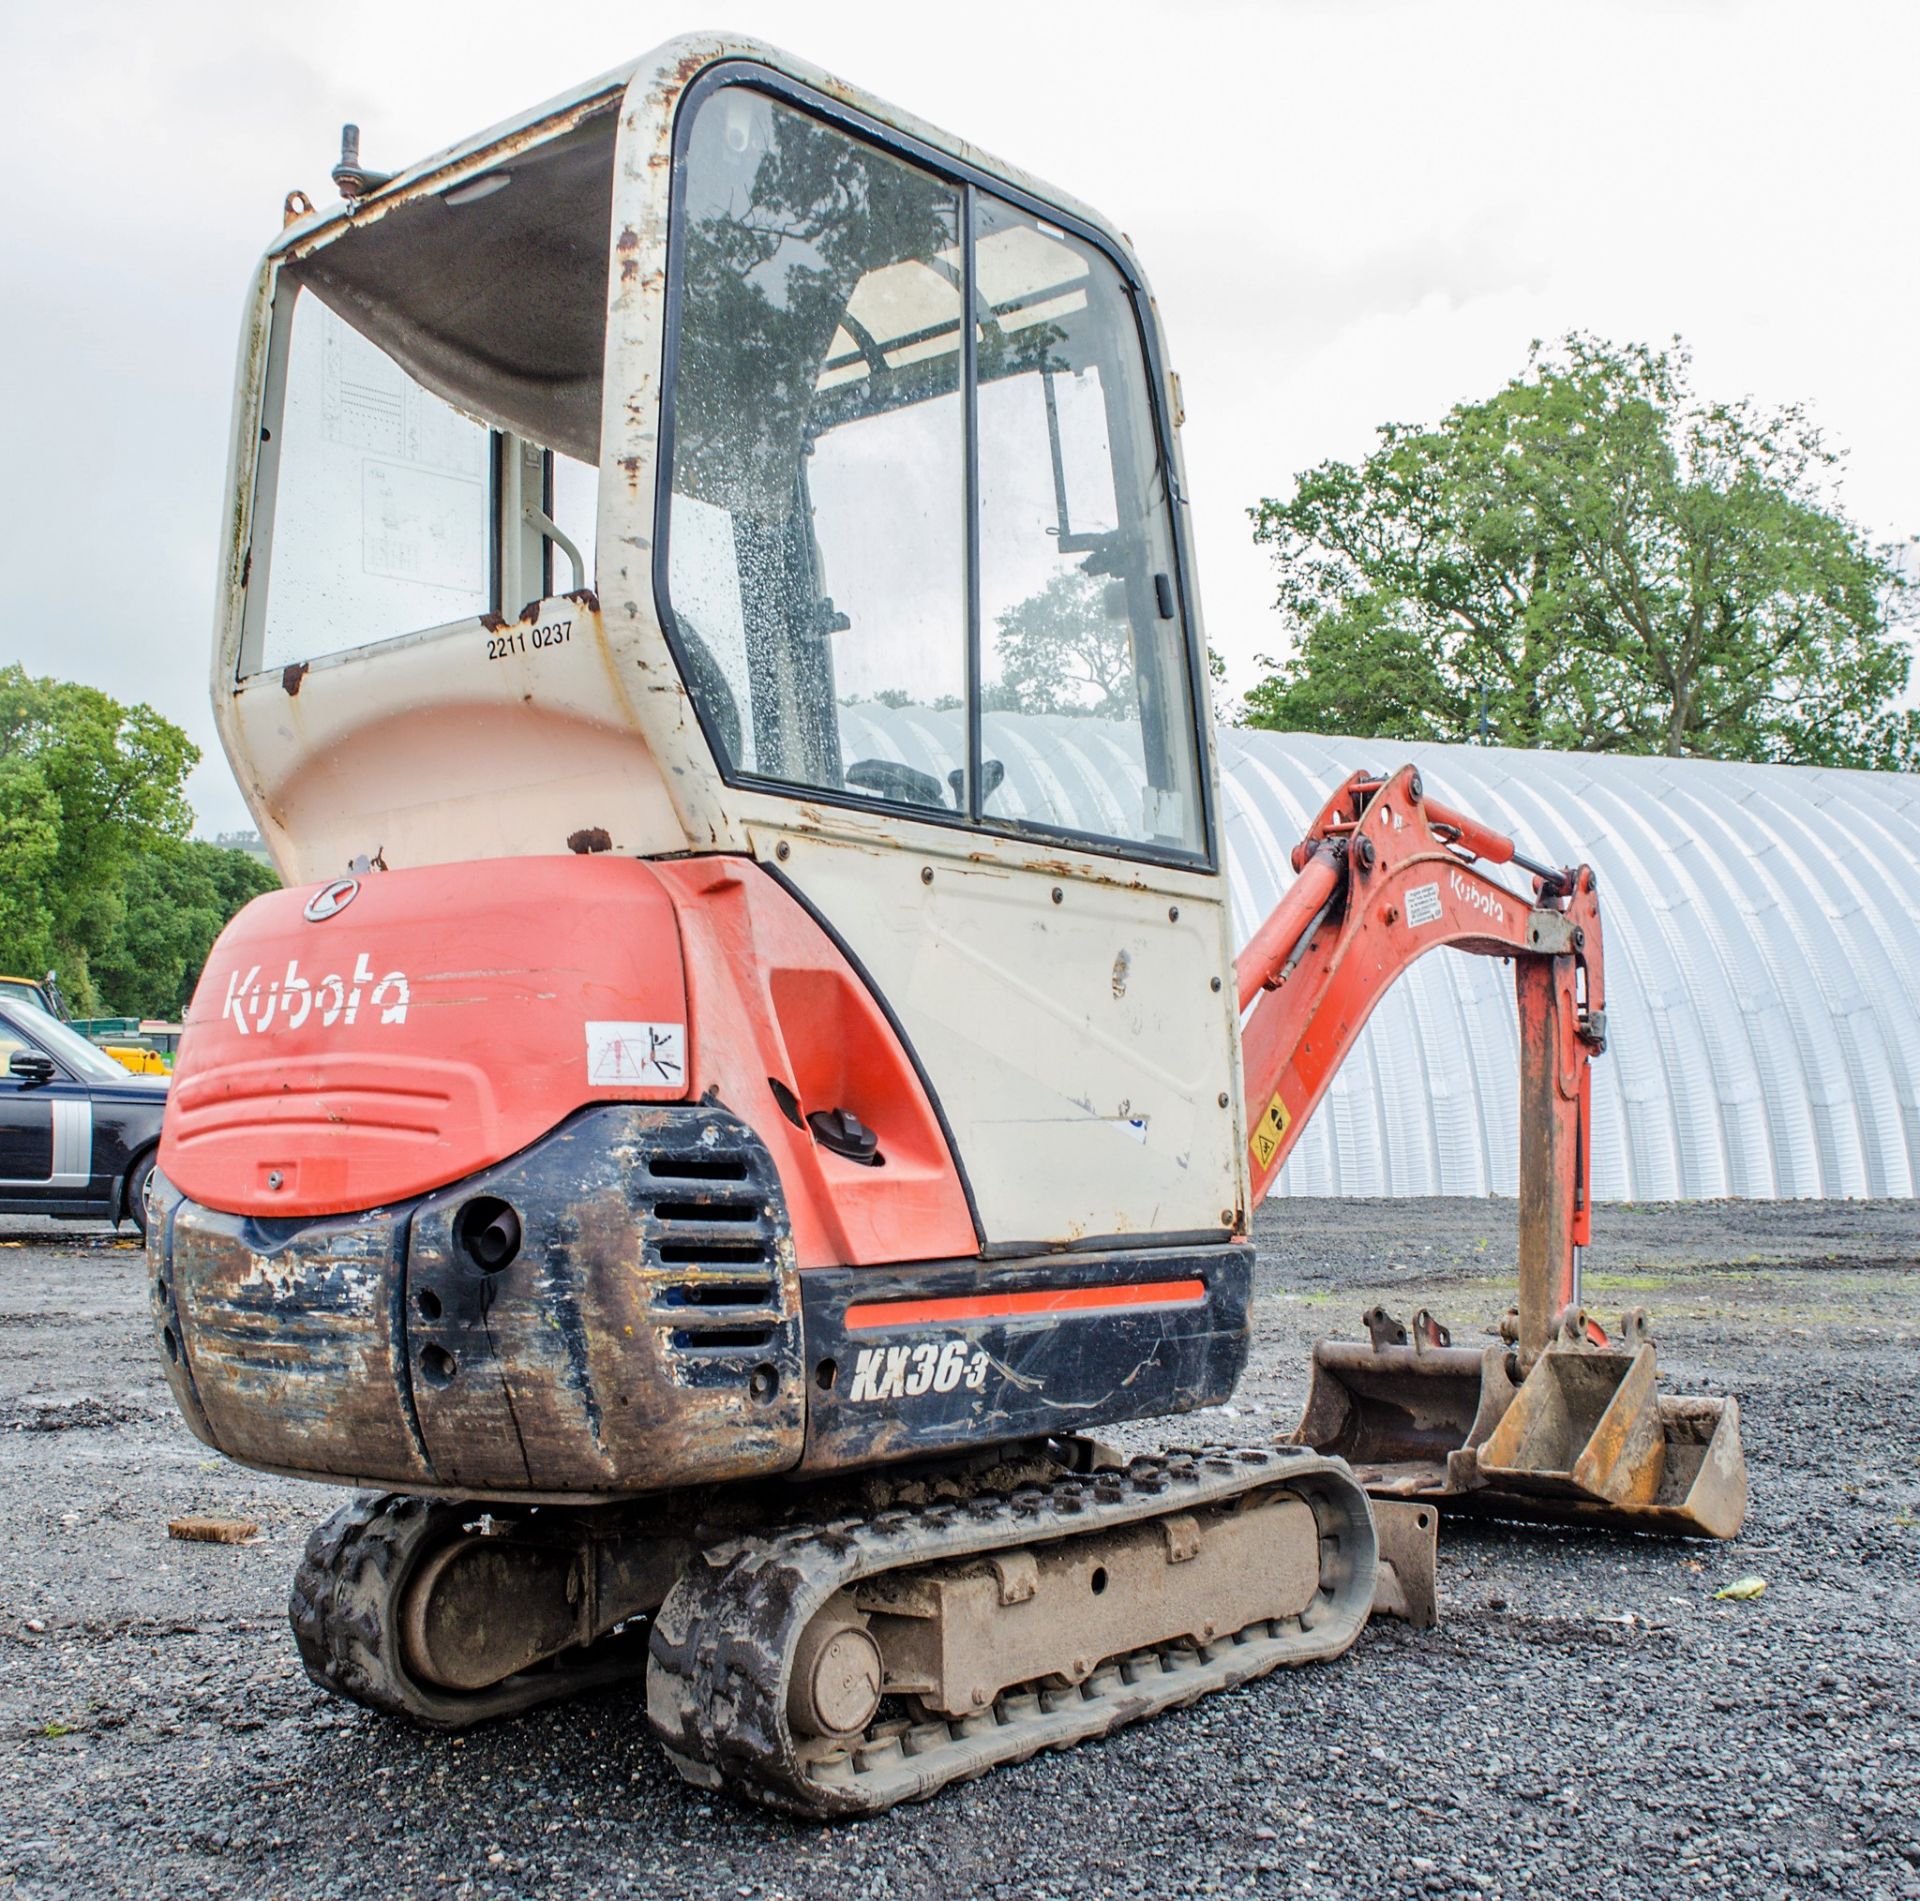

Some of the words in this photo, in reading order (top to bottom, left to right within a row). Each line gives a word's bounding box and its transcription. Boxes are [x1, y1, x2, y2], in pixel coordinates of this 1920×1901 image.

[487, 633, 526, 660] 2211
[532, 621, 572, 649] 0237
[1450, 870, 1504, 922] Kubota
[222, 953, 410, 1034] Kubota
[849, 1340, 990, 1402] KX36-3
